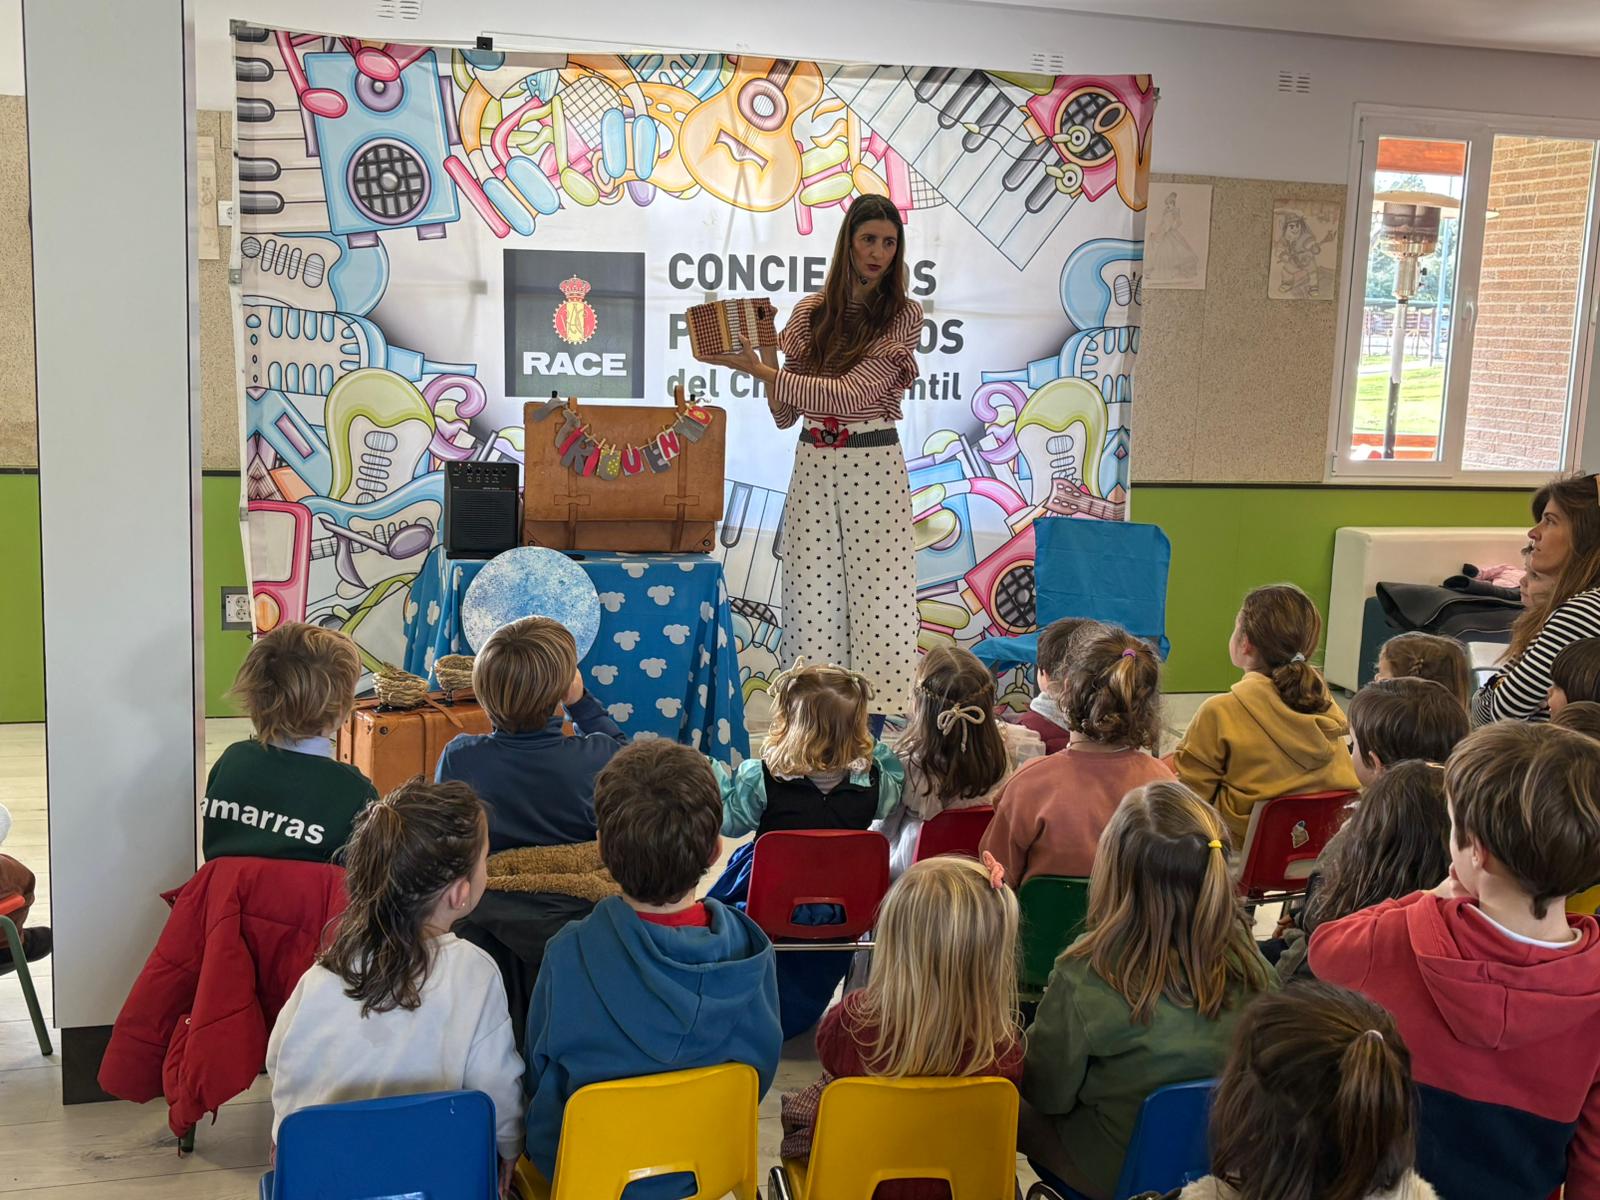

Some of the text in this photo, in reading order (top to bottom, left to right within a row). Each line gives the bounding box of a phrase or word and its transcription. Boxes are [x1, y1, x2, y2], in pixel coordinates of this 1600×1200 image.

[668, 253, 937, 296] CONCIES
[523, 351, 627, 377] RACE
[667, 368, 719, 398] del
